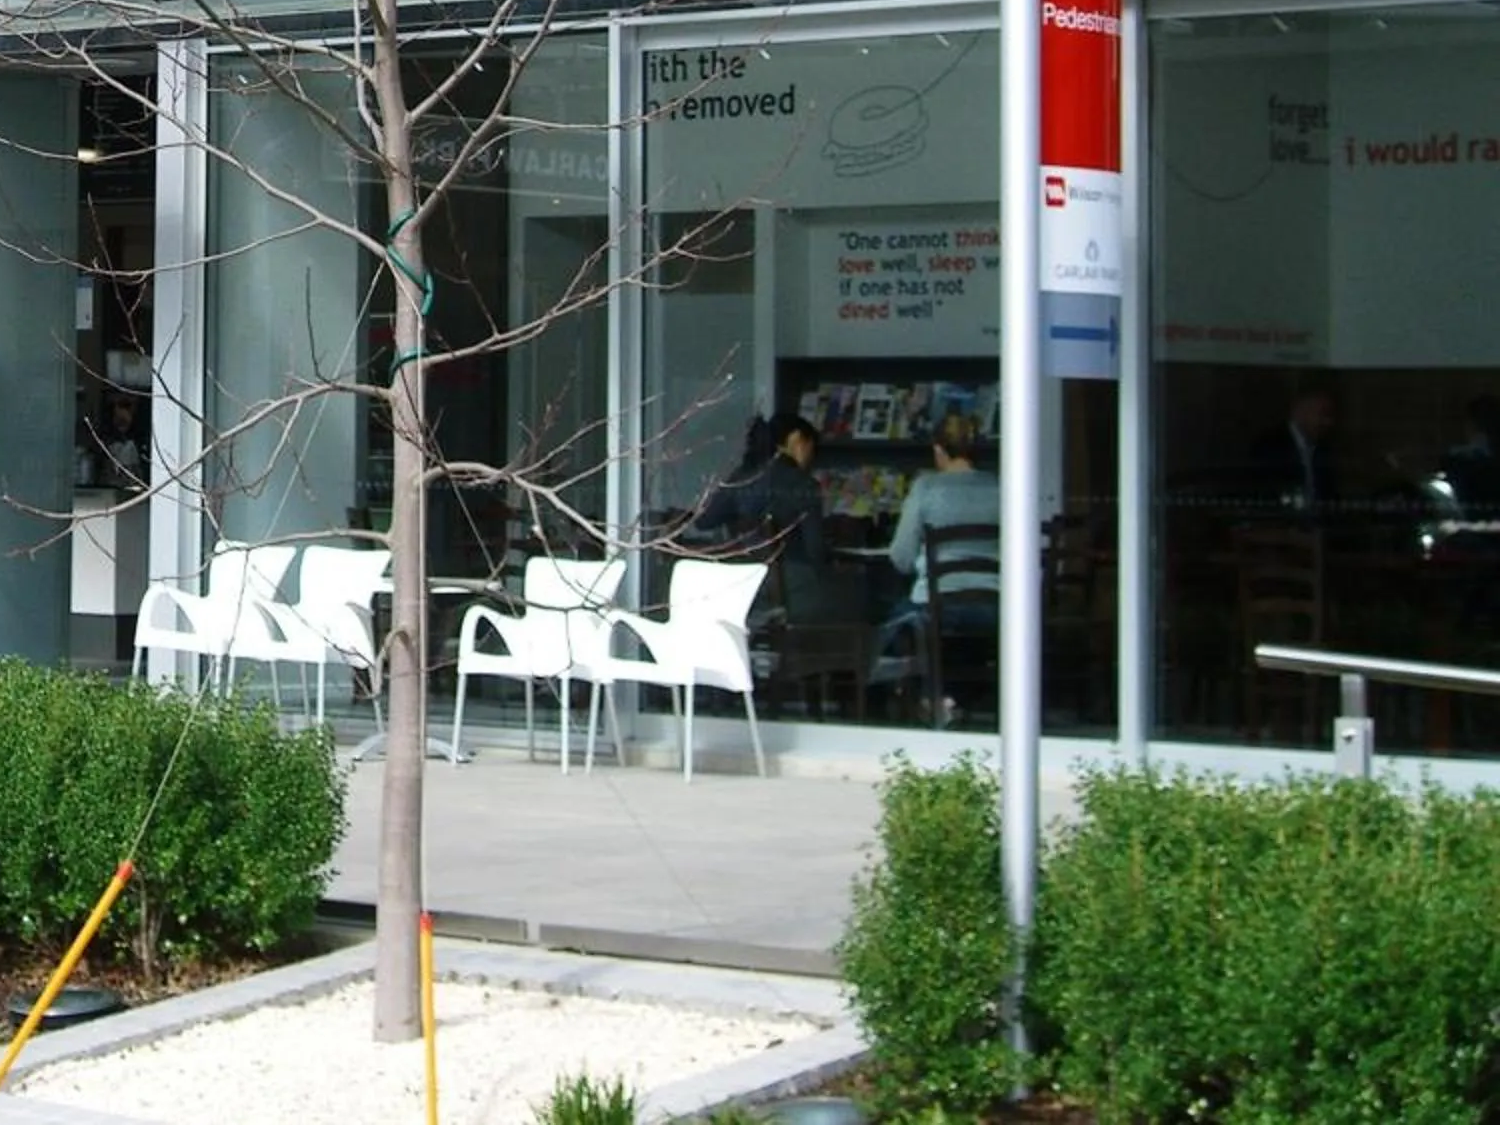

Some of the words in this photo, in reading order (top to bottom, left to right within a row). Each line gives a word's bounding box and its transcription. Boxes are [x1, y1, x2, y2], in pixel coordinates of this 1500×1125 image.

[698, 51, 746, 79] the
[670, 83, 796, 121] removed
[1345, 136, 1355, 166] i
[1365, 132, 1457, 166] would
[886, 231, 949, 250] cannot
[928, 254, 977, 275] sleep
[858, 281, 893, 297] one
[897, 278, 929, 295] has
[933, 278, 965, 296] not
[838, 300, 890, 320] dined
